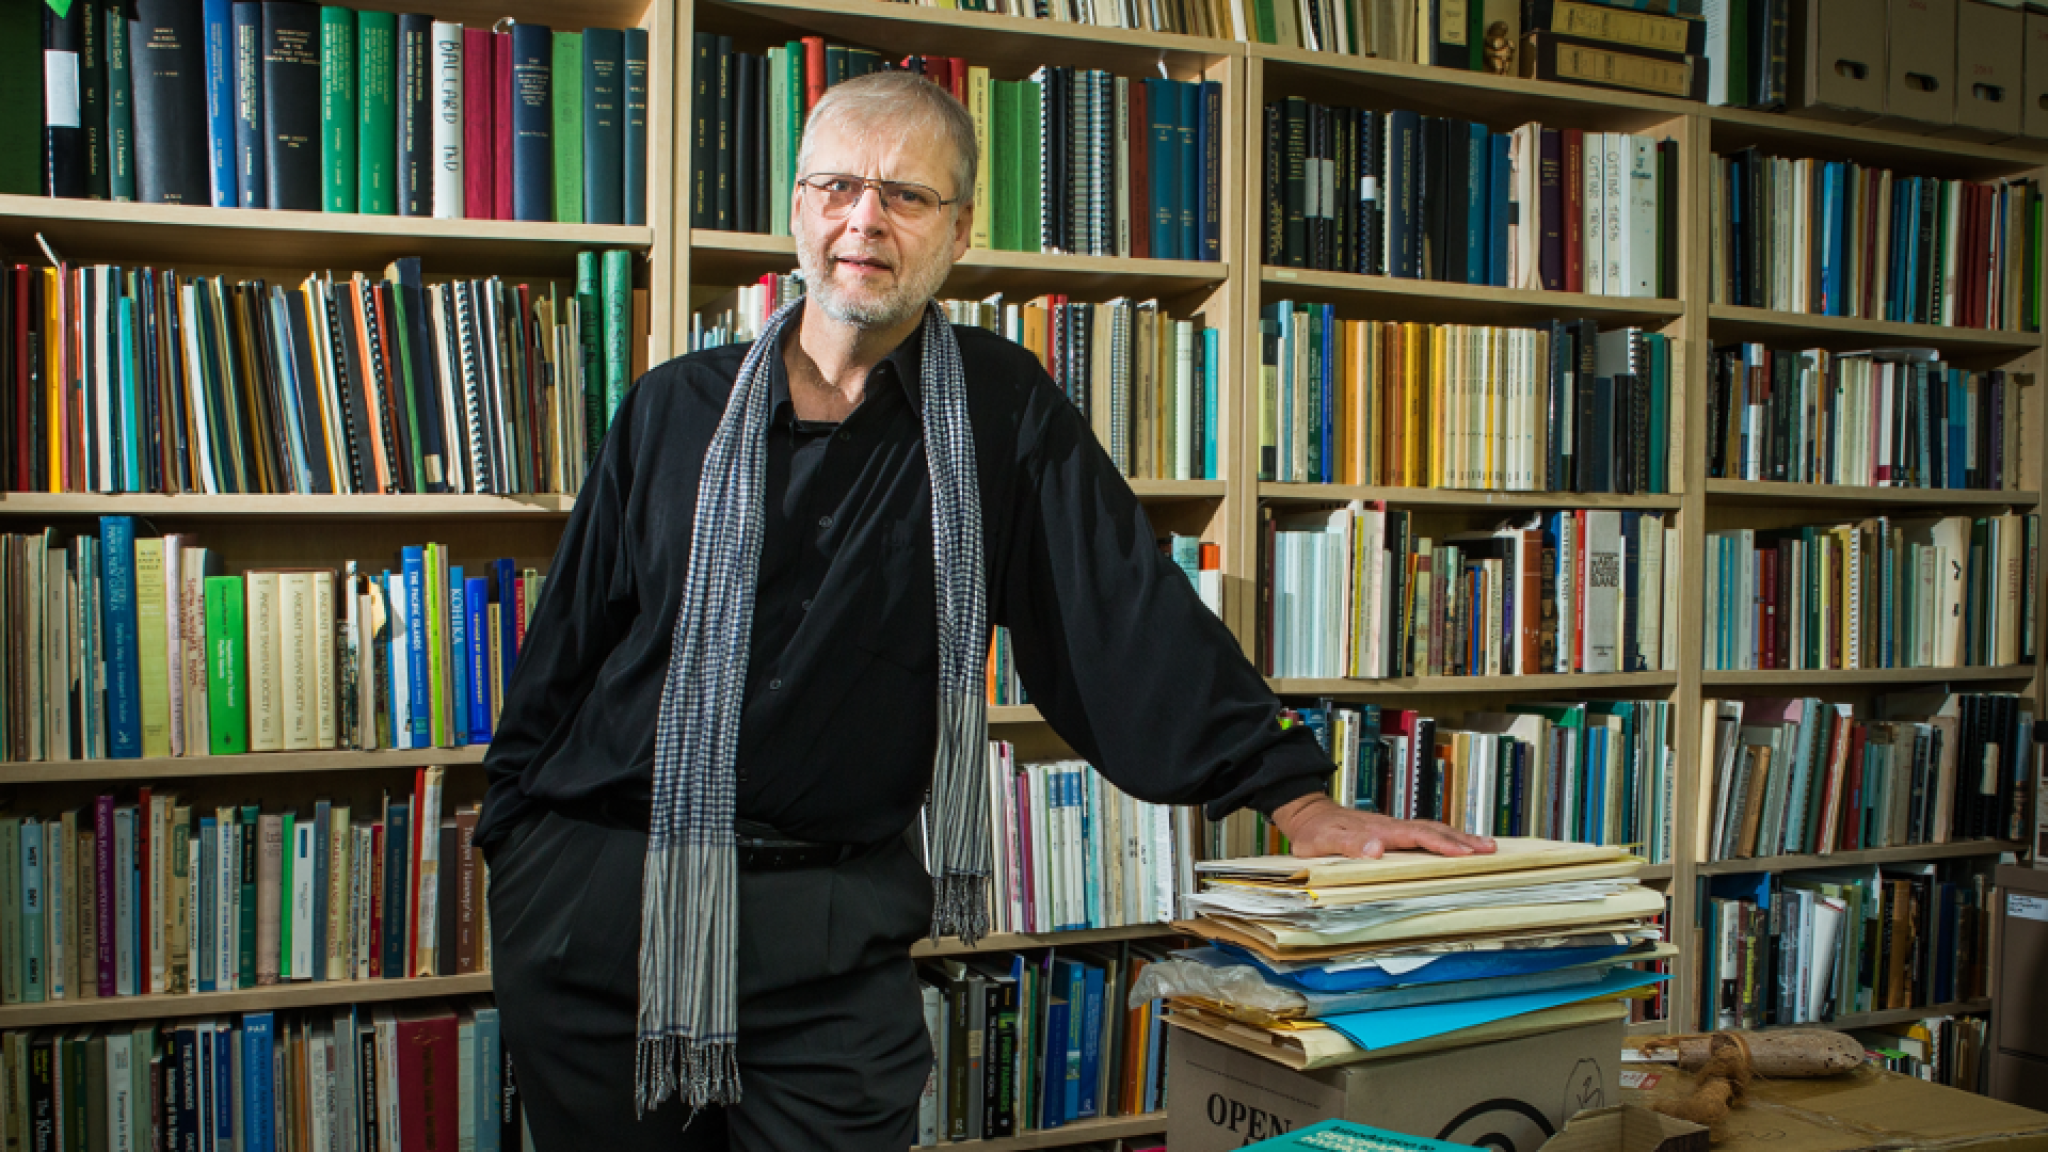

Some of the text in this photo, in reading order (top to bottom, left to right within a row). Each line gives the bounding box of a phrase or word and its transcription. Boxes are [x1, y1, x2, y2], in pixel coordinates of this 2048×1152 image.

[438, 40, 461, 126] BALLARD
[410, 570, 419, 585] THE
[412, 617, 423, 650] ISLANDS
[451, 588, 464, 645] KOHIKA
[1207, 1092, 1292, 1142] OPEN
